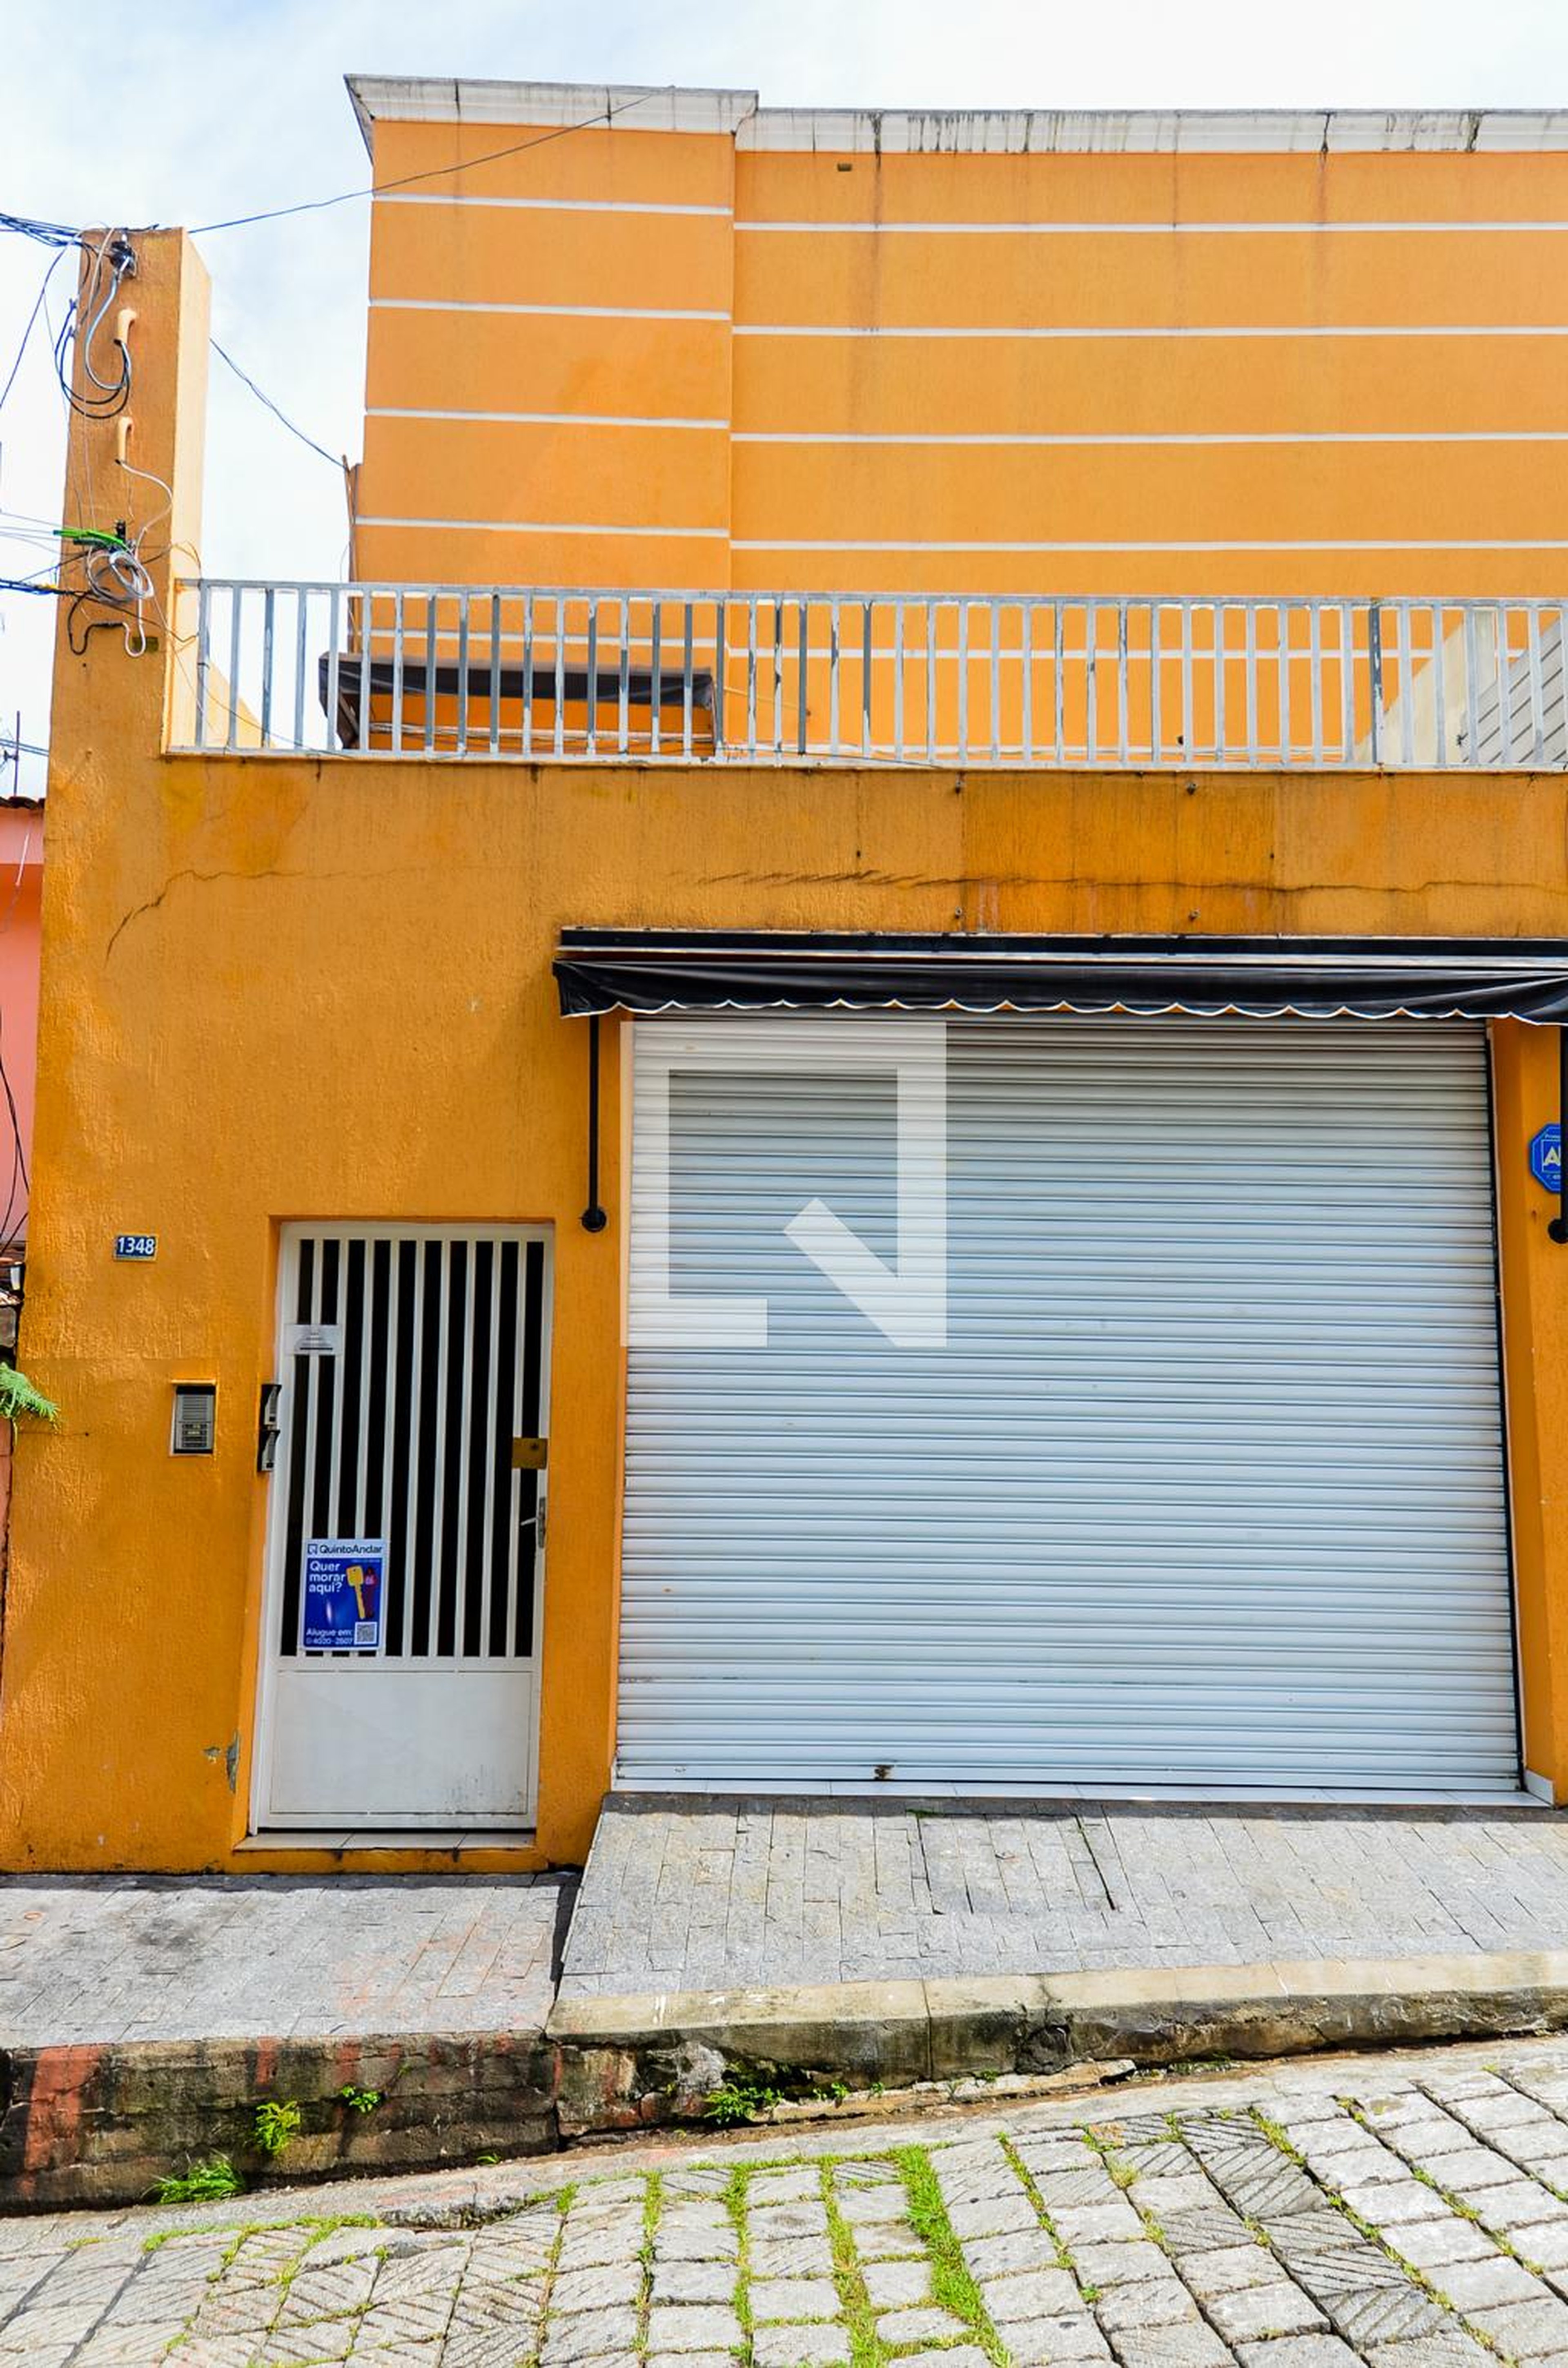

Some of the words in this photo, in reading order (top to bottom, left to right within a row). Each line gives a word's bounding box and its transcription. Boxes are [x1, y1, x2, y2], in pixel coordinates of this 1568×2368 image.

[118, 1237, 154, 1254] 1348
[319, 1544, 382, 1553] QuintoAndar
[310, 1561, 341, 1572] Quer
[309, 1574, 346, 1582] morar
[309, 1581, 342, 1595] aqui?
